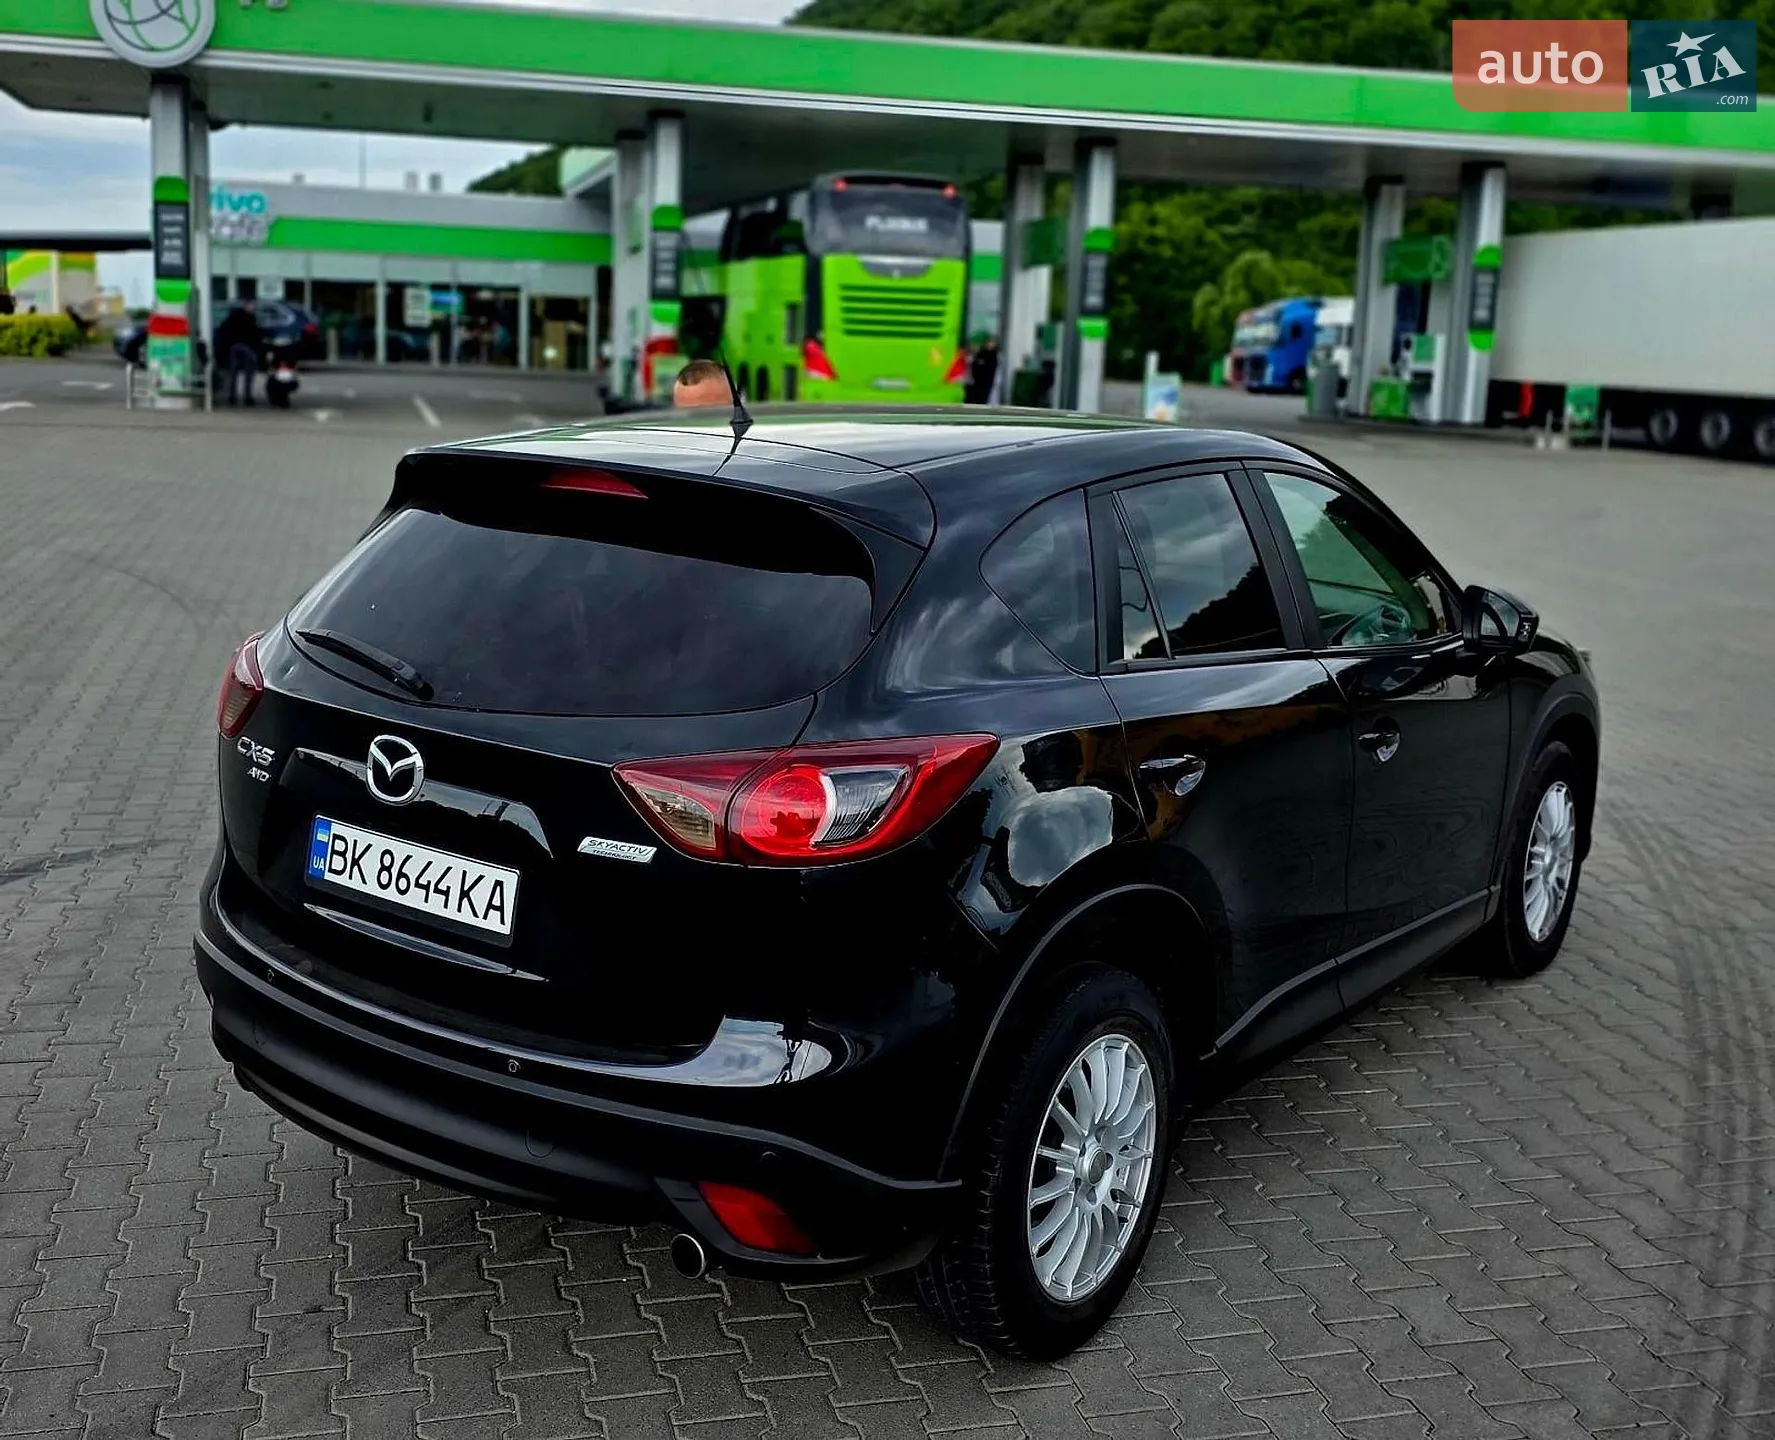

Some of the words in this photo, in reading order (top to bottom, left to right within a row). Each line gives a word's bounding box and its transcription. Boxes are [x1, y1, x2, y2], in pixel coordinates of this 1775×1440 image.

[587, 839, 648, 854] SKYACTIV
[312, 855, 326, 872] UA
[327, 833, 374, 885] BK
[376, 848, 454, 908] 8644
[456, 869, 507, 926] KA
